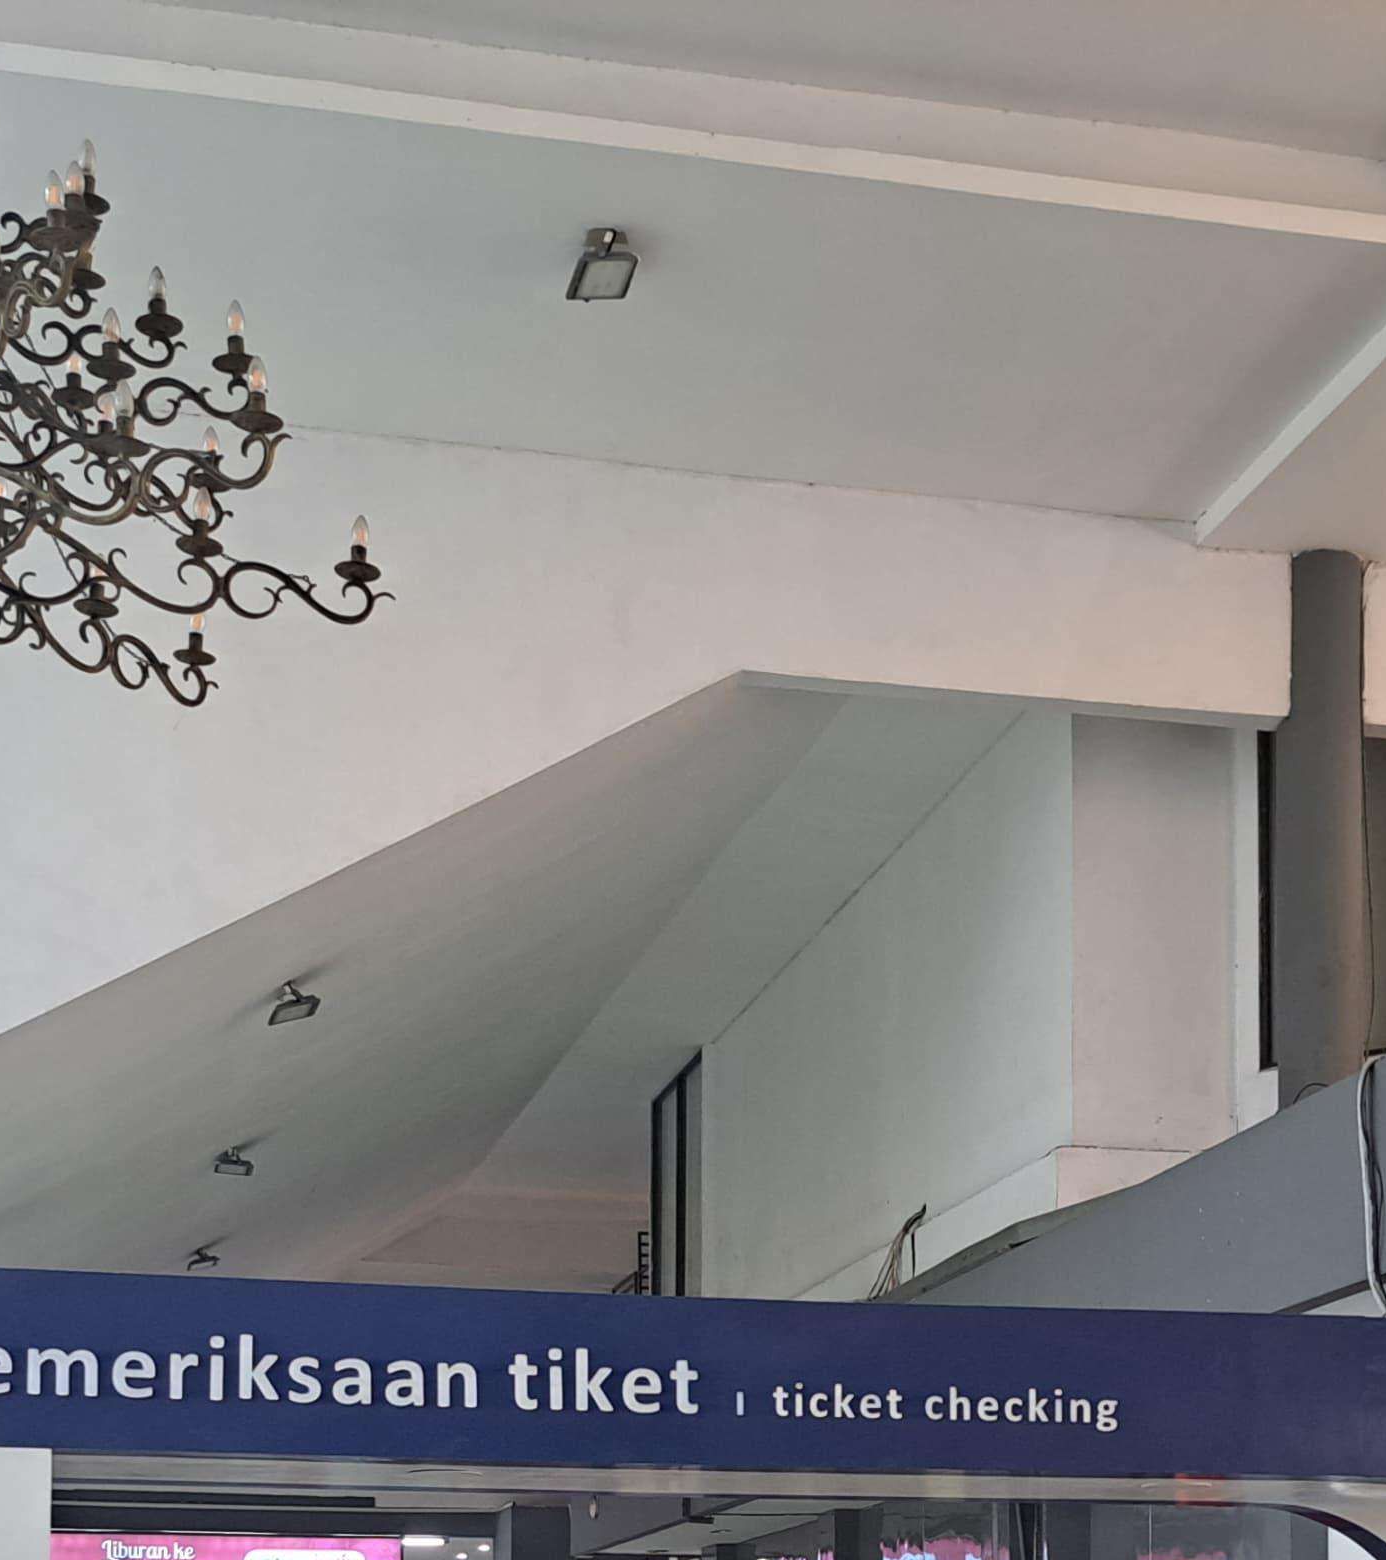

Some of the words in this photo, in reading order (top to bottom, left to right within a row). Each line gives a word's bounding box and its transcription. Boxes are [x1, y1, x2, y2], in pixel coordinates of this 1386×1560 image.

[508, 1346, 699, 1415] tiket
[773, 1382, 903, 1421] ticket
[925, 1387, 1119, 1432] checking
[173, 1539, 196, 1560] ke
